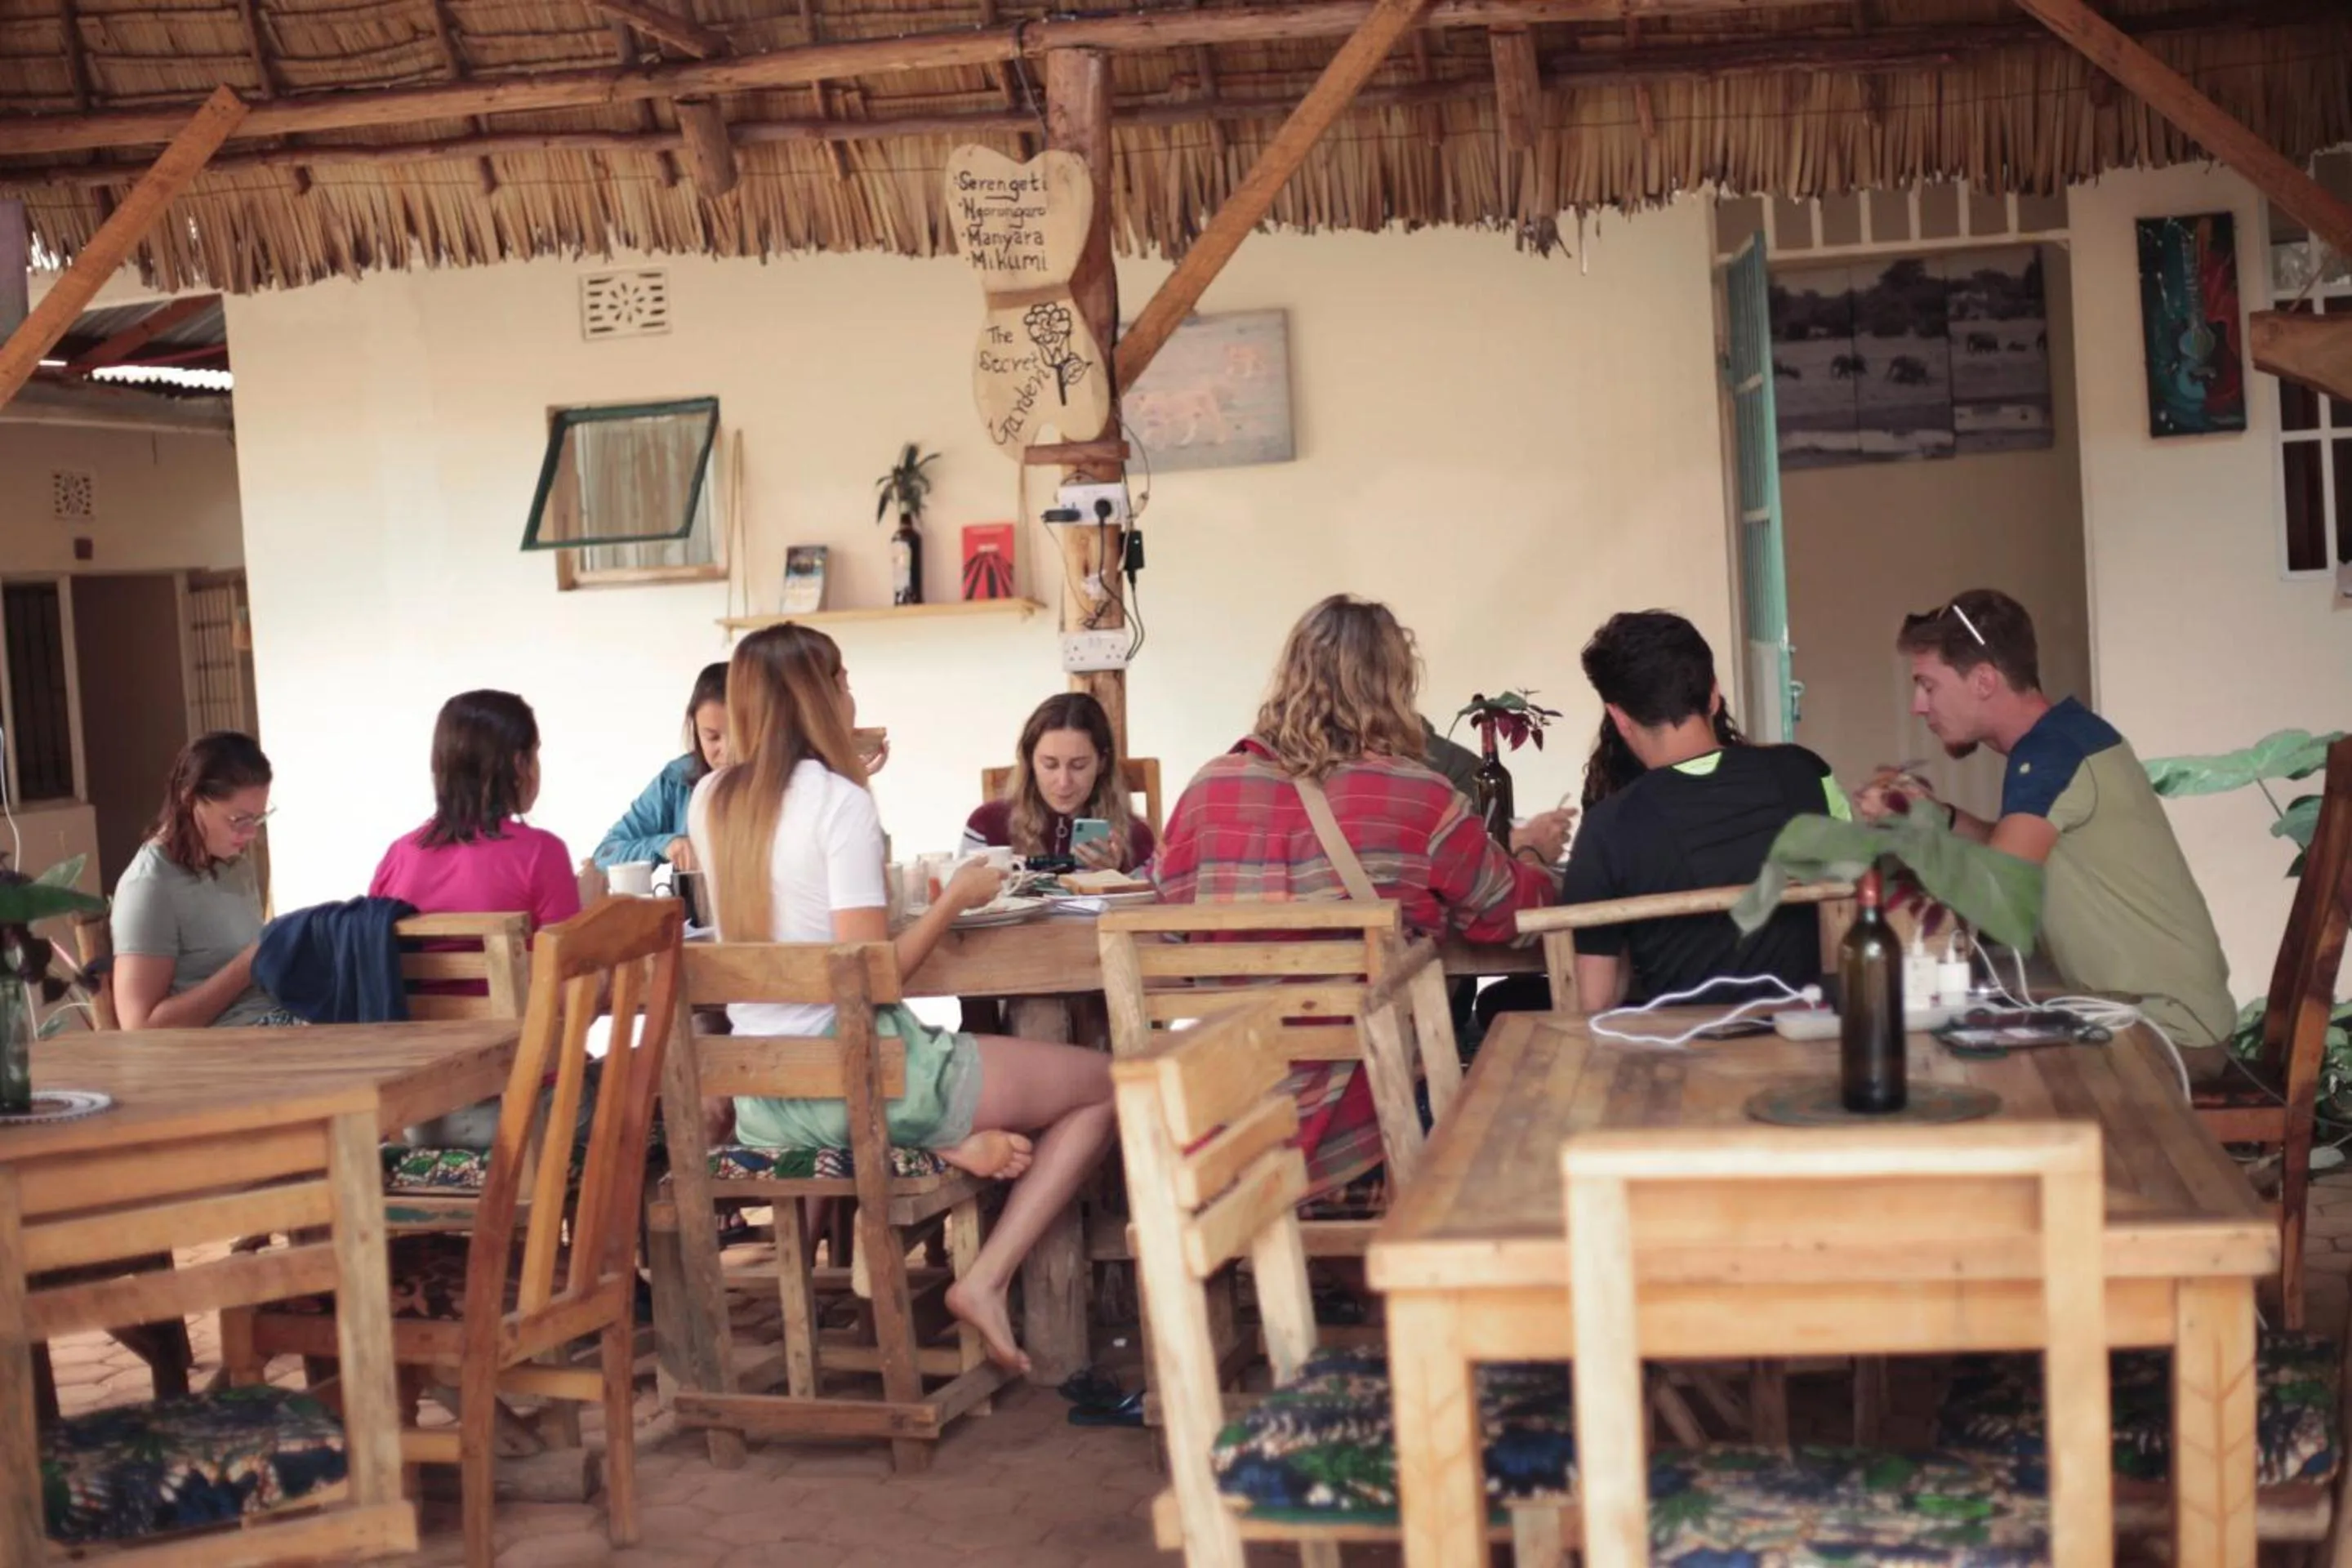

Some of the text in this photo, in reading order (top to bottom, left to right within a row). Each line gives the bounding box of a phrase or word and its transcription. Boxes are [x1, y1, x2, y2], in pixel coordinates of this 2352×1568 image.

[959, 170, 1048, 203] Serengeti
[967, 225, 1044, 252] Manyara
[971, 247, 1048, 271] Mikumi
[987, 325, 1013, 343] The
[988, 369, 1050, 445] Garden
